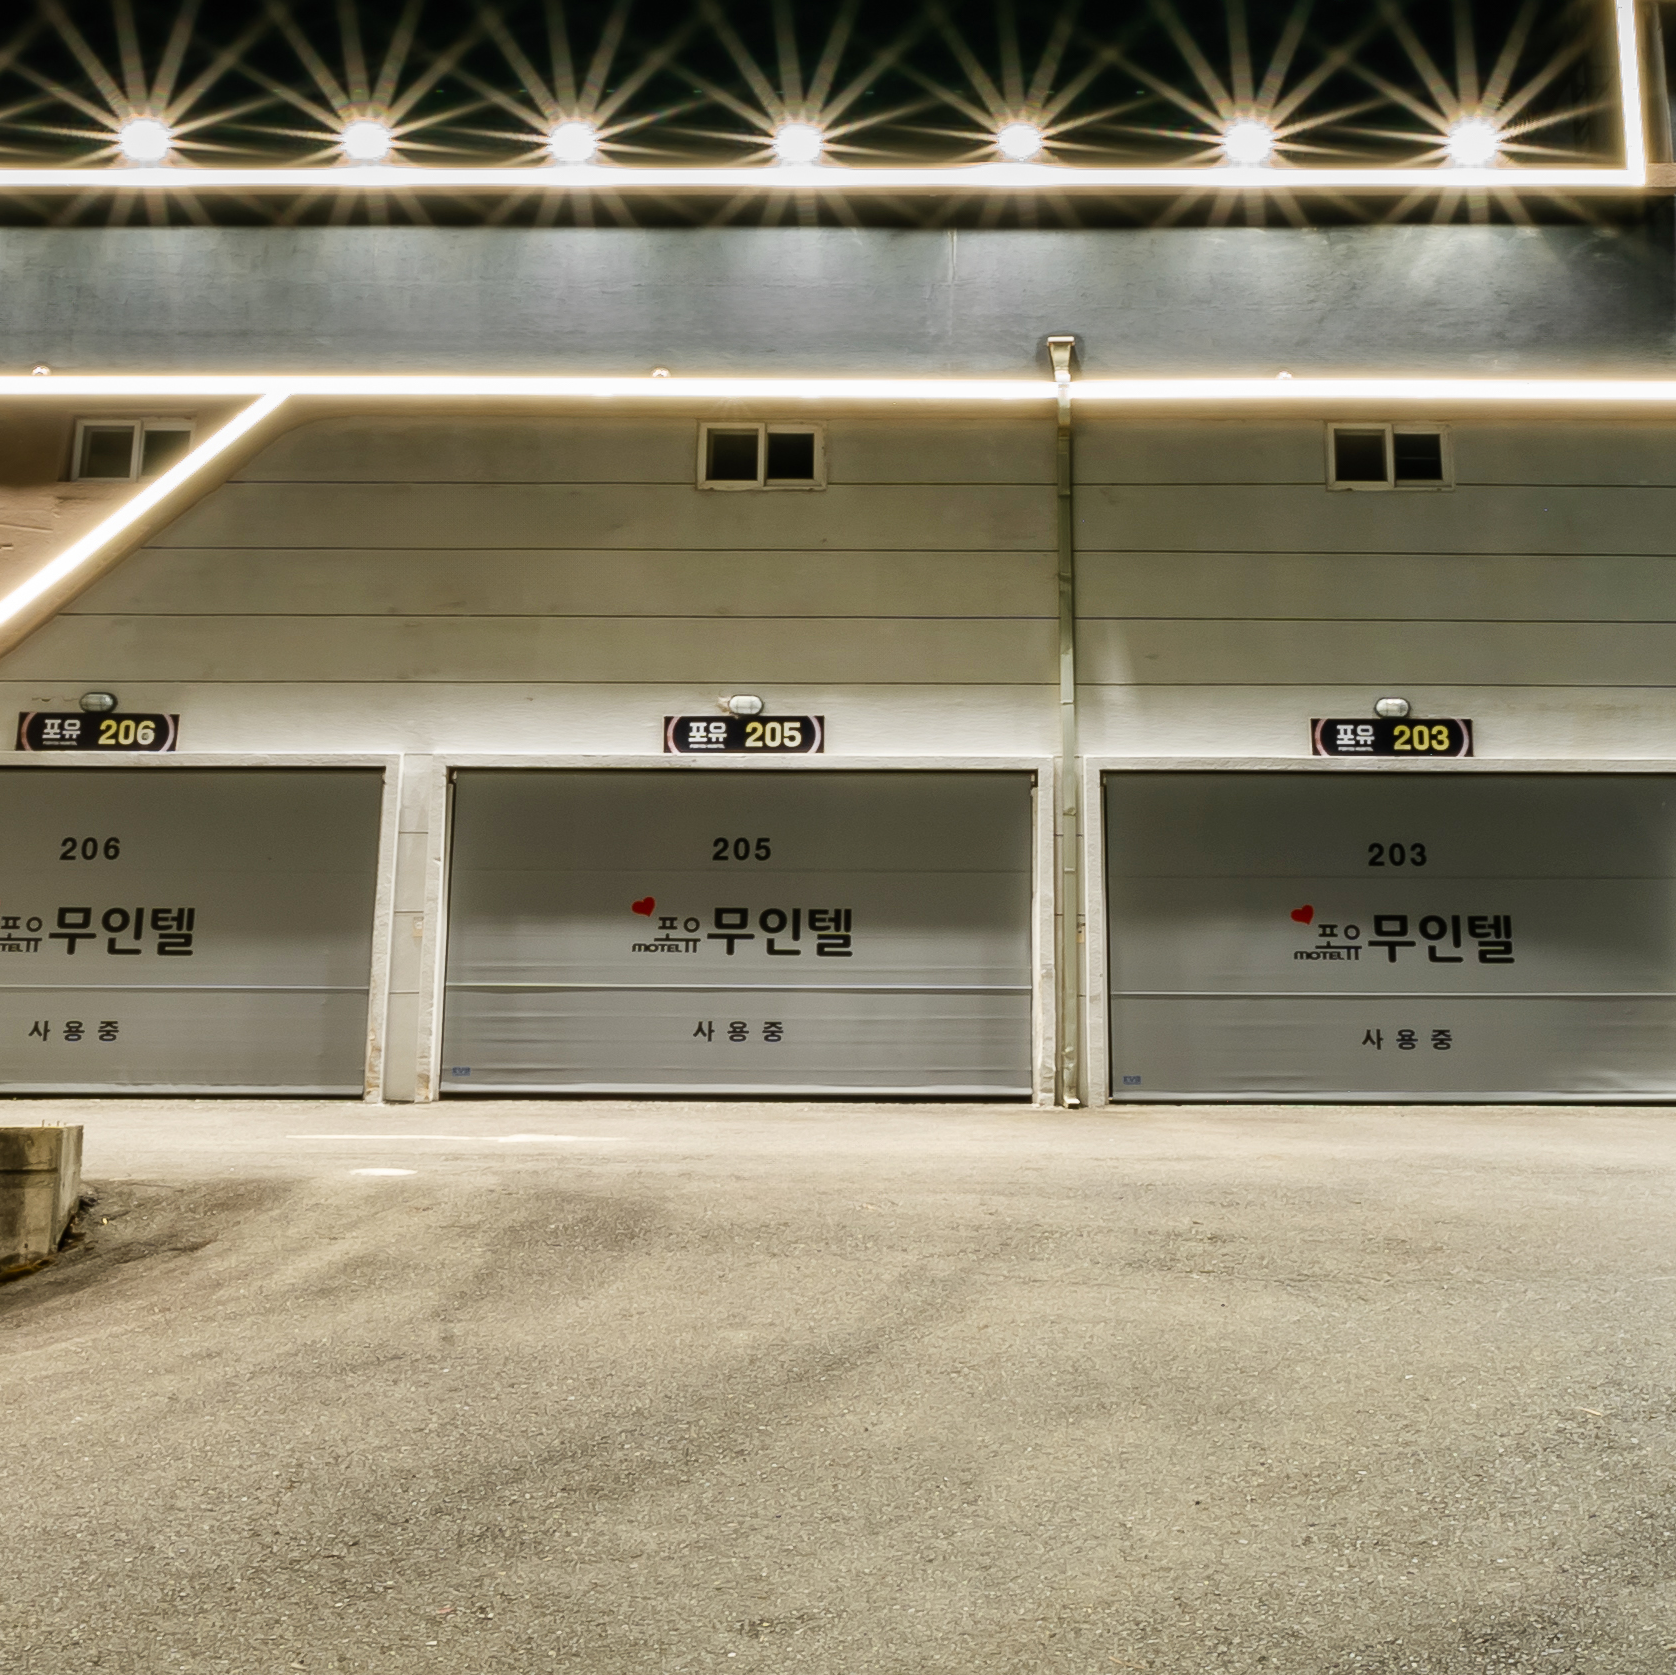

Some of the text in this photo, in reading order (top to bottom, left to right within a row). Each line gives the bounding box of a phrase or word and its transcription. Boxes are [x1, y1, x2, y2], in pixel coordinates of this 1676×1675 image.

[42, 719, 156, 745] 포유 206
[688, 721, 802, 748] 포유 205
[1336, 724, 1450, 751] 포유 203
[59, 836, 121, 860] 206
[712, 837, 772, 861] 205
[1368, 842, 1428, 867] 203
[48, 907, 196, 956] 무인텔
[654, 907, 853, 957] 포유 무인텔
[1315, 914, 1515, 964] 포유 무인텔
